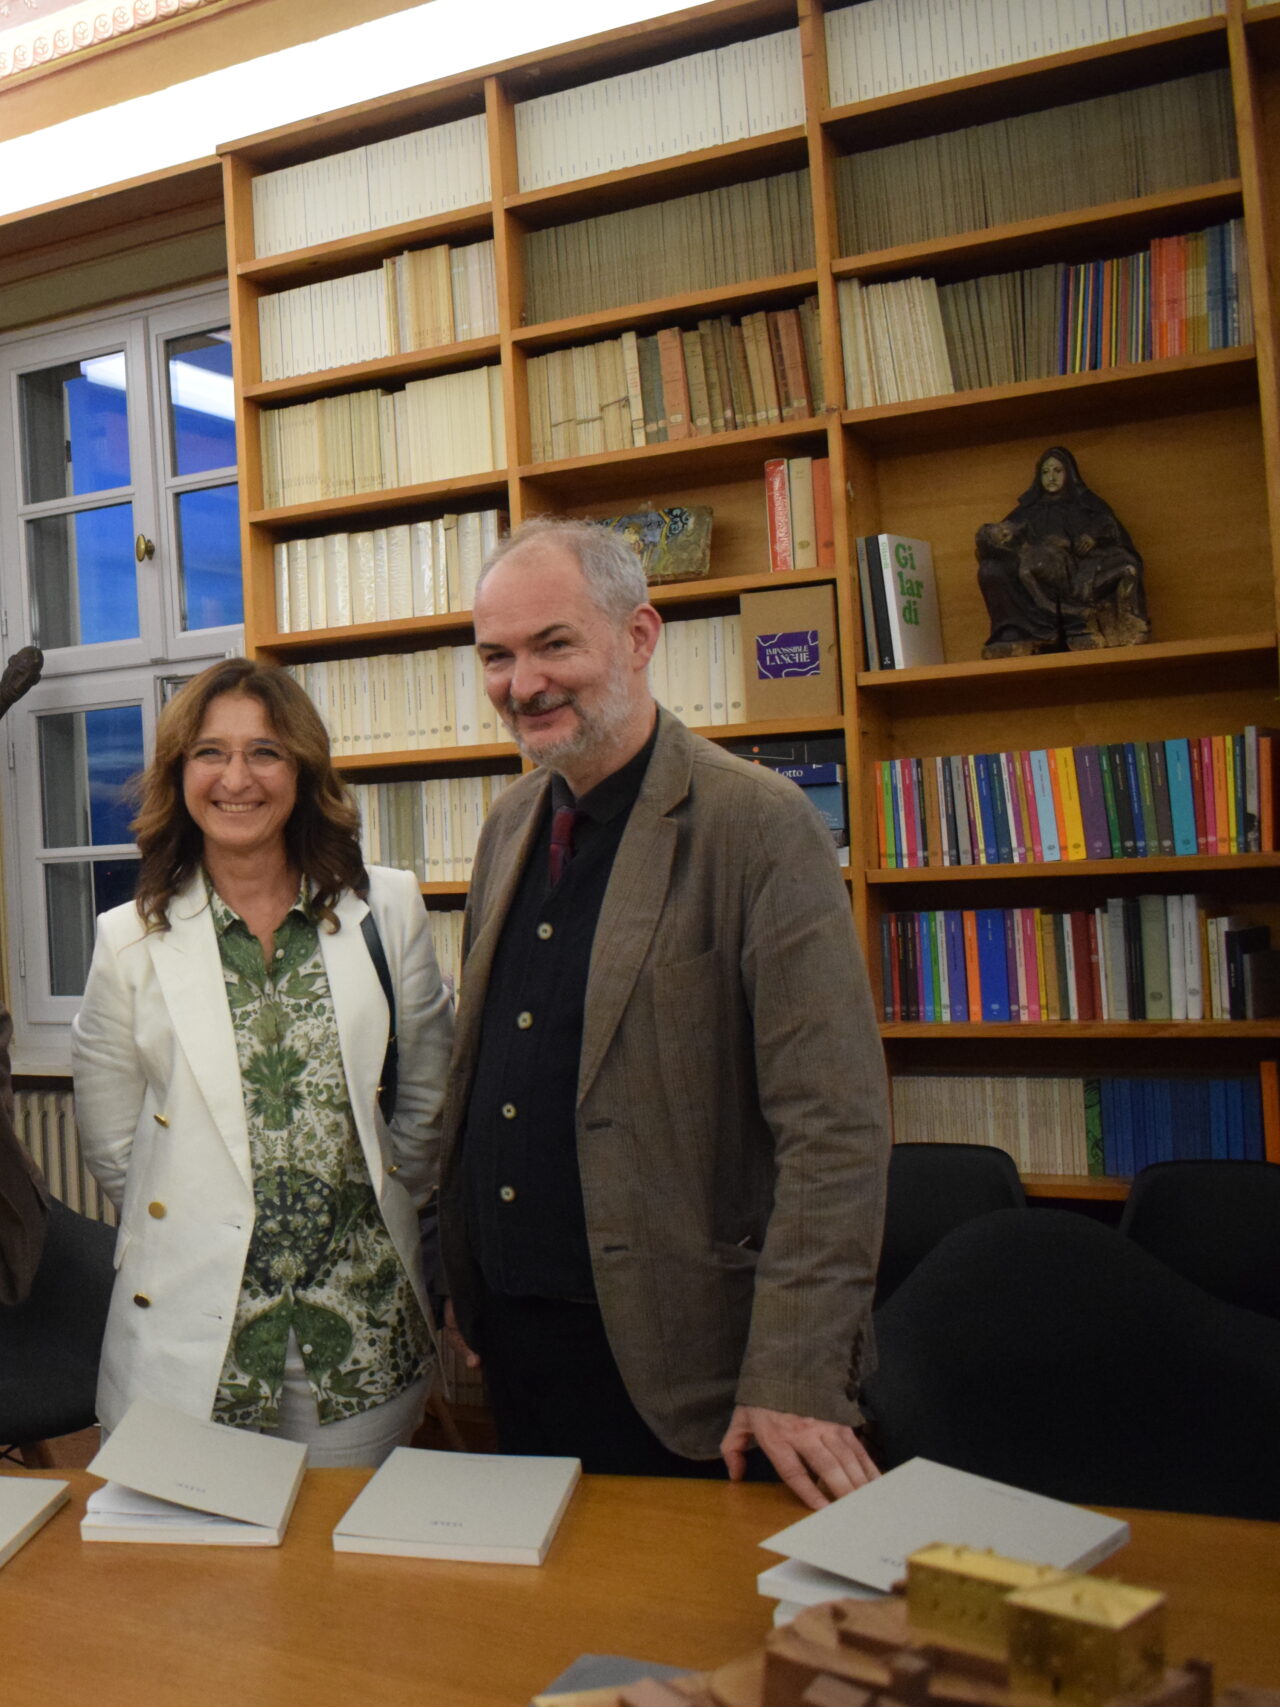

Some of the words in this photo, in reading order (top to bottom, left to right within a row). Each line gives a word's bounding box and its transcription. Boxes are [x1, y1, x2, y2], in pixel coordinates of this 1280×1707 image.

[894, 543, 917, 570] Gi
[896, 570, 924, 598] lar
[901, 599, 920, 625] di
[765, 645, 809, 656] IMPOSSIBLE
[766, 652, 811, 666] LANGHE
